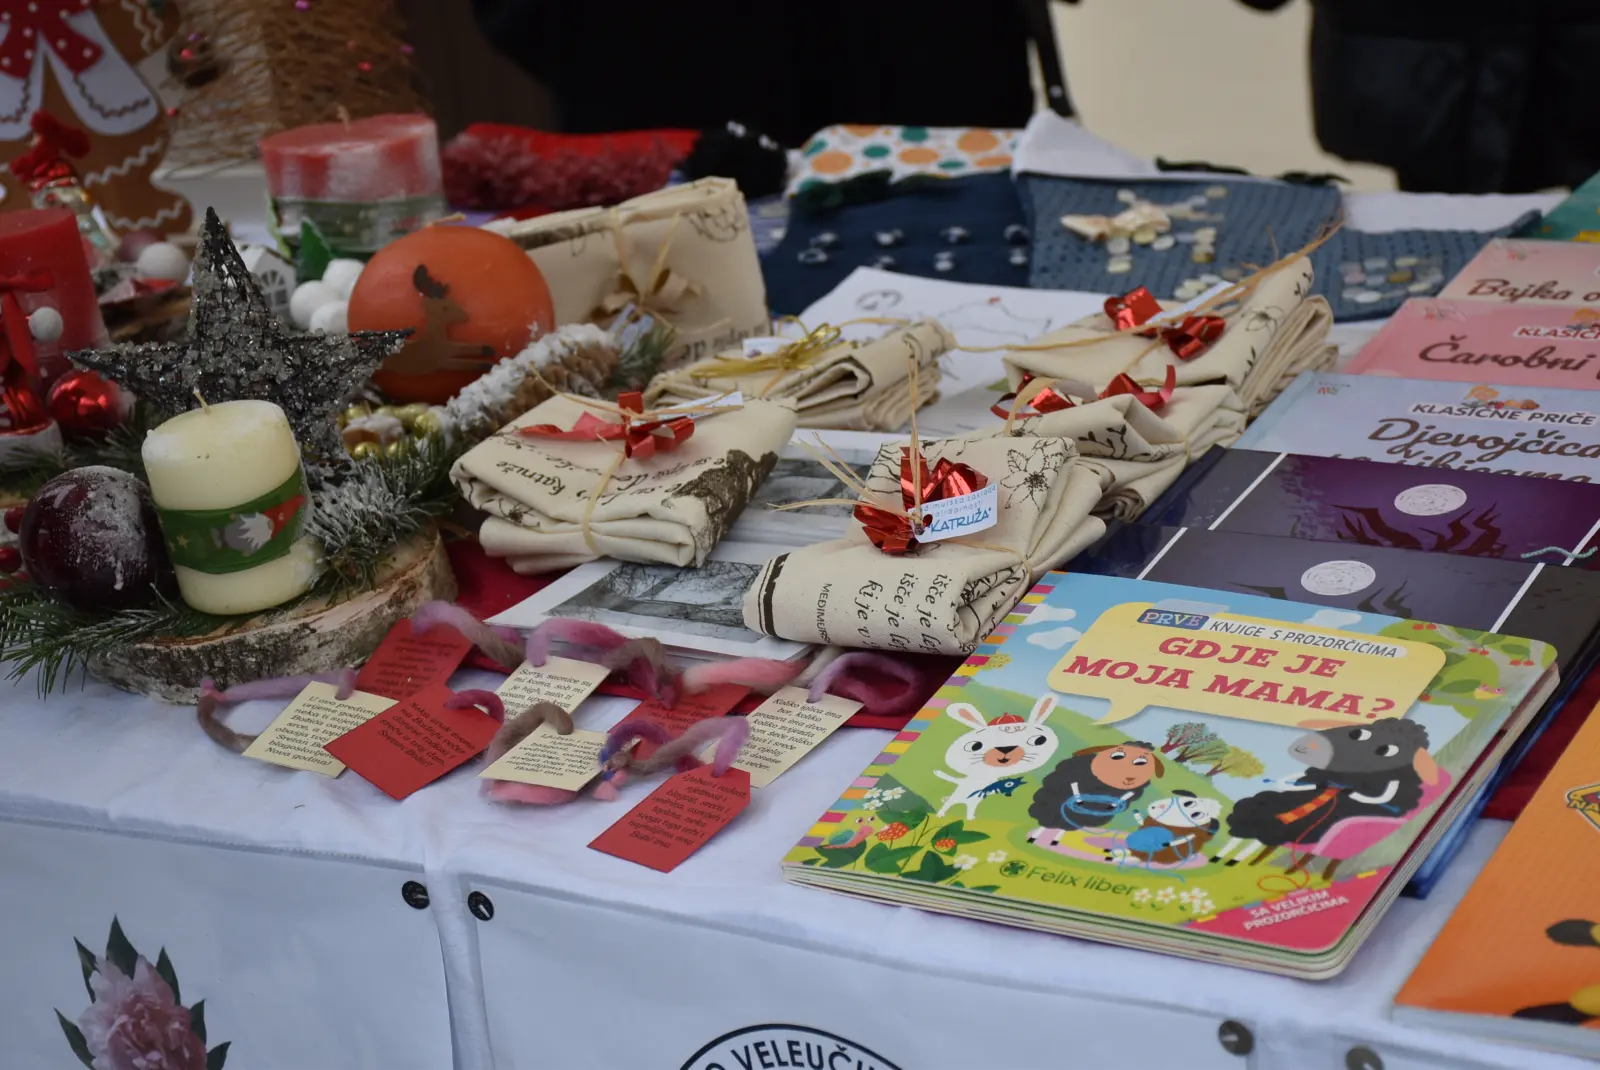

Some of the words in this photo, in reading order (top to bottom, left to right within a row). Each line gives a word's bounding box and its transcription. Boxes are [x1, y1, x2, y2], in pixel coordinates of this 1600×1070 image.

[1467, 278, 1573, 304] Bajka
[1419, 335, 1597, 372] Čarobni
[1412, 404, 1522, 420] KLASIČNE
[1527, 412, 1596, 425] PRIČE
[1368, 418, 1600, 463] Djevojčica
[893, 572, 919, 605] išče
[925, 573, 953, 605] išče
[854, 597, 875, 620] je
[884, 604, 905, 628] je
[916, 603, 938, 629] je
[1143, 611, 1205, 627] PRVE
[1209, 621, 1264, 638] KNJIGE
[1269, 628, 1280, 640] S
[1283, 631, 1398, 658] PROZORČIĆIMA
[1158, 637, 1279, 668] GDJE
[1283, 654, 1346, 678] JE
[1063, 656, 1194, 689] MOJA
[1202, 674, 1396, 719] MAMA?
[1027, 865, 1081, 887] Felix
[1083, 875, 1139, 896] liber
[1249, 905, 1270, 919] SA
